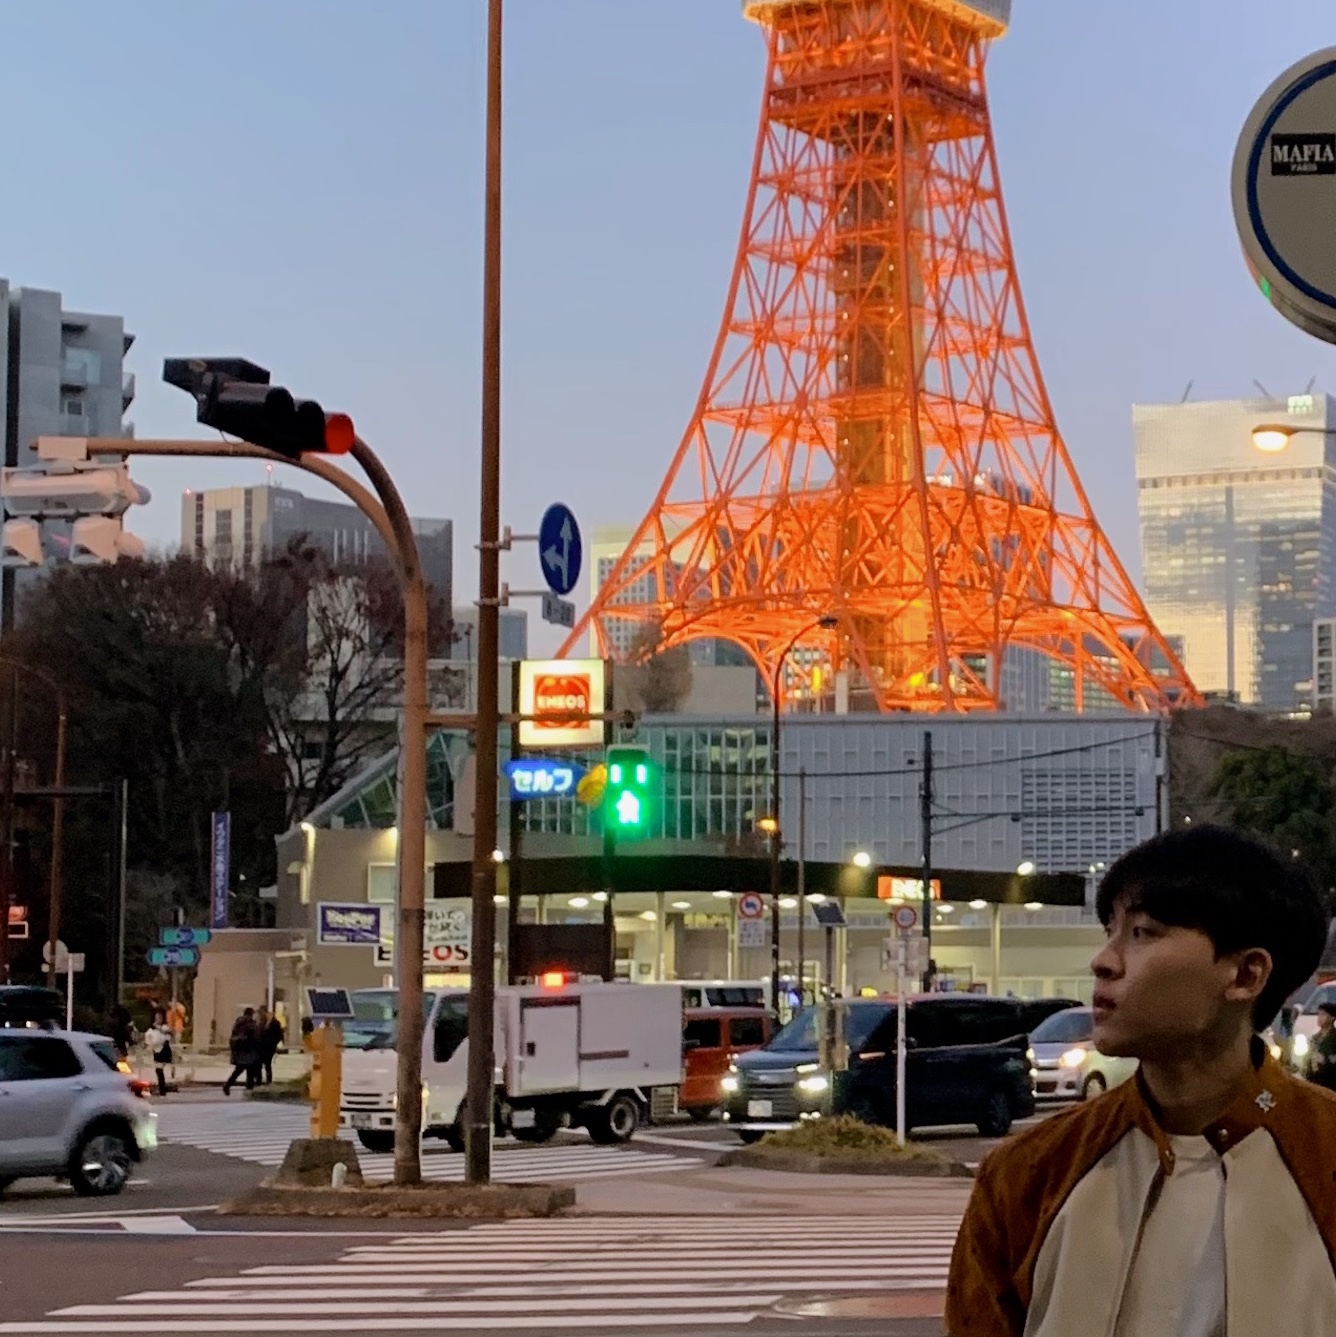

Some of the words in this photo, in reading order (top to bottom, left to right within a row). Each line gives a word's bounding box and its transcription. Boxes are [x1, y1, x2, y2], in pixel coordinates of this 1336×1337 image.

[1273, 144, 1334, 163] MAFIA
[537, 693, 586, 710] ENEOS
[512, 767, 573, 793] セルフ
